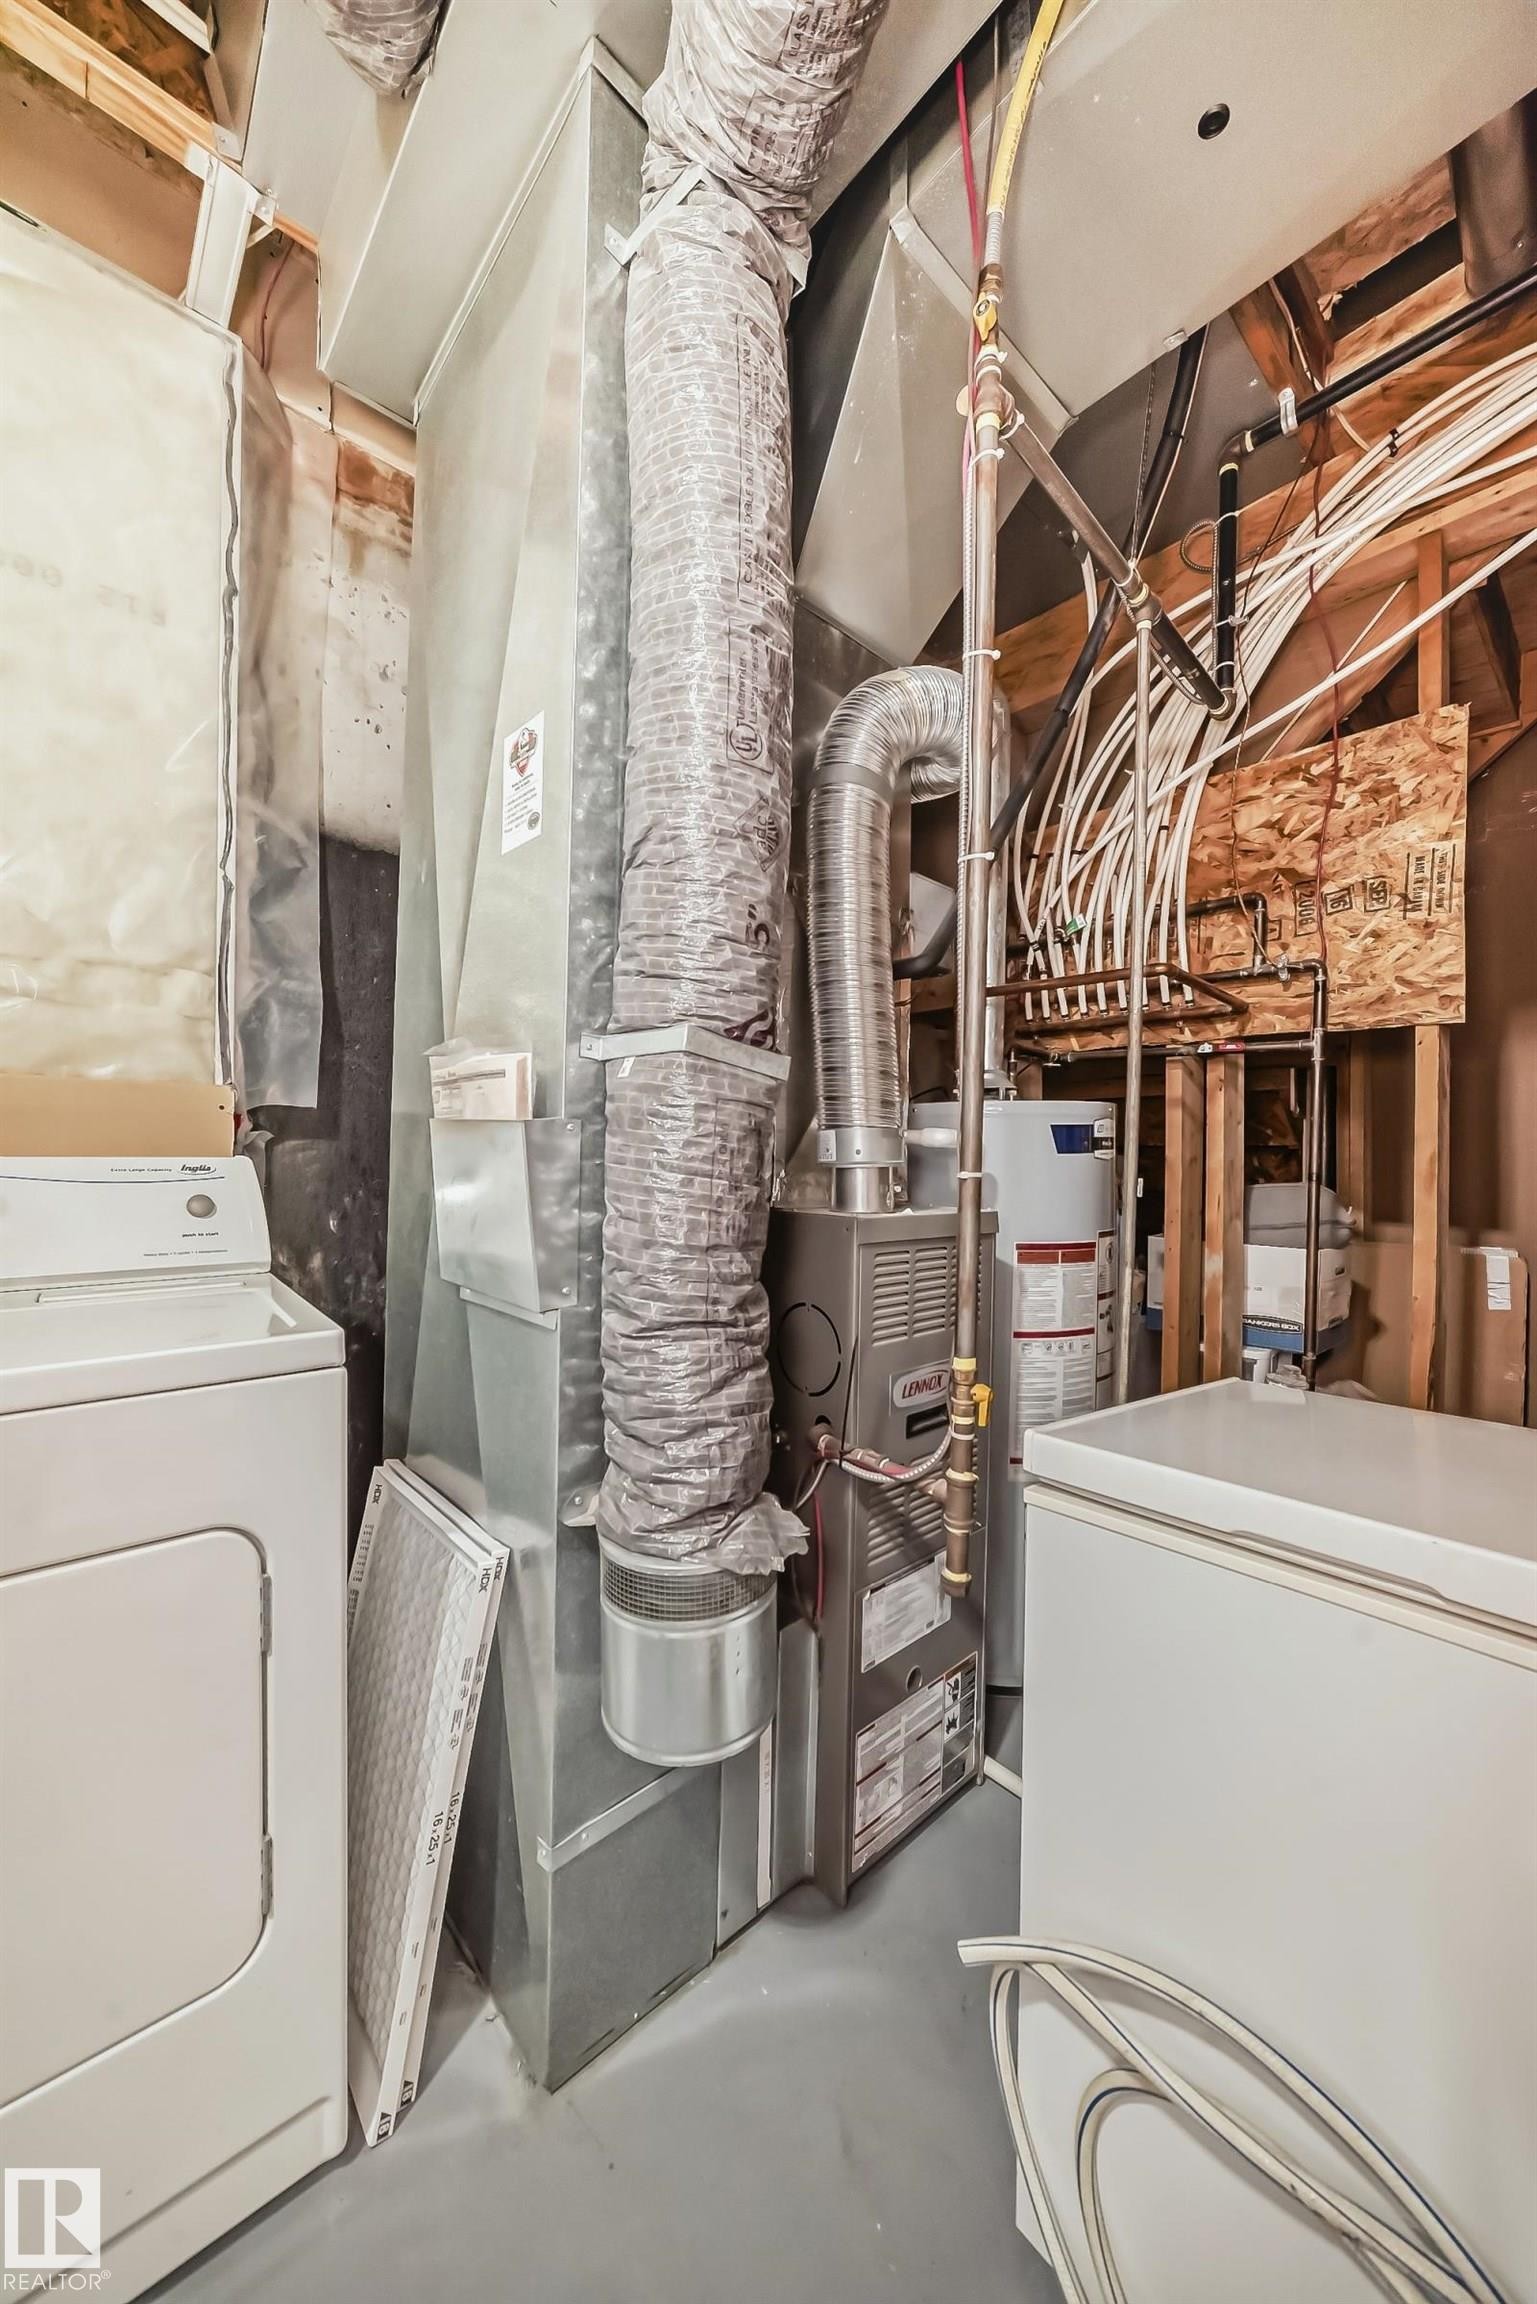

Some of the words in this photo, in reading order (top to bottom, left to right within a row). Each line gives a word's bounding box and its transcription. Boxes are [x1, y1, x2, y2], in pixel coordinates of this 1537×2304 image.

[180, 1163, 212, 1173] Inglis
[902, 1373, 944, 1399] LENNOX
[478, 1567, 492, 1594] HDX
[493, 1556, 505, 1581] HDX
